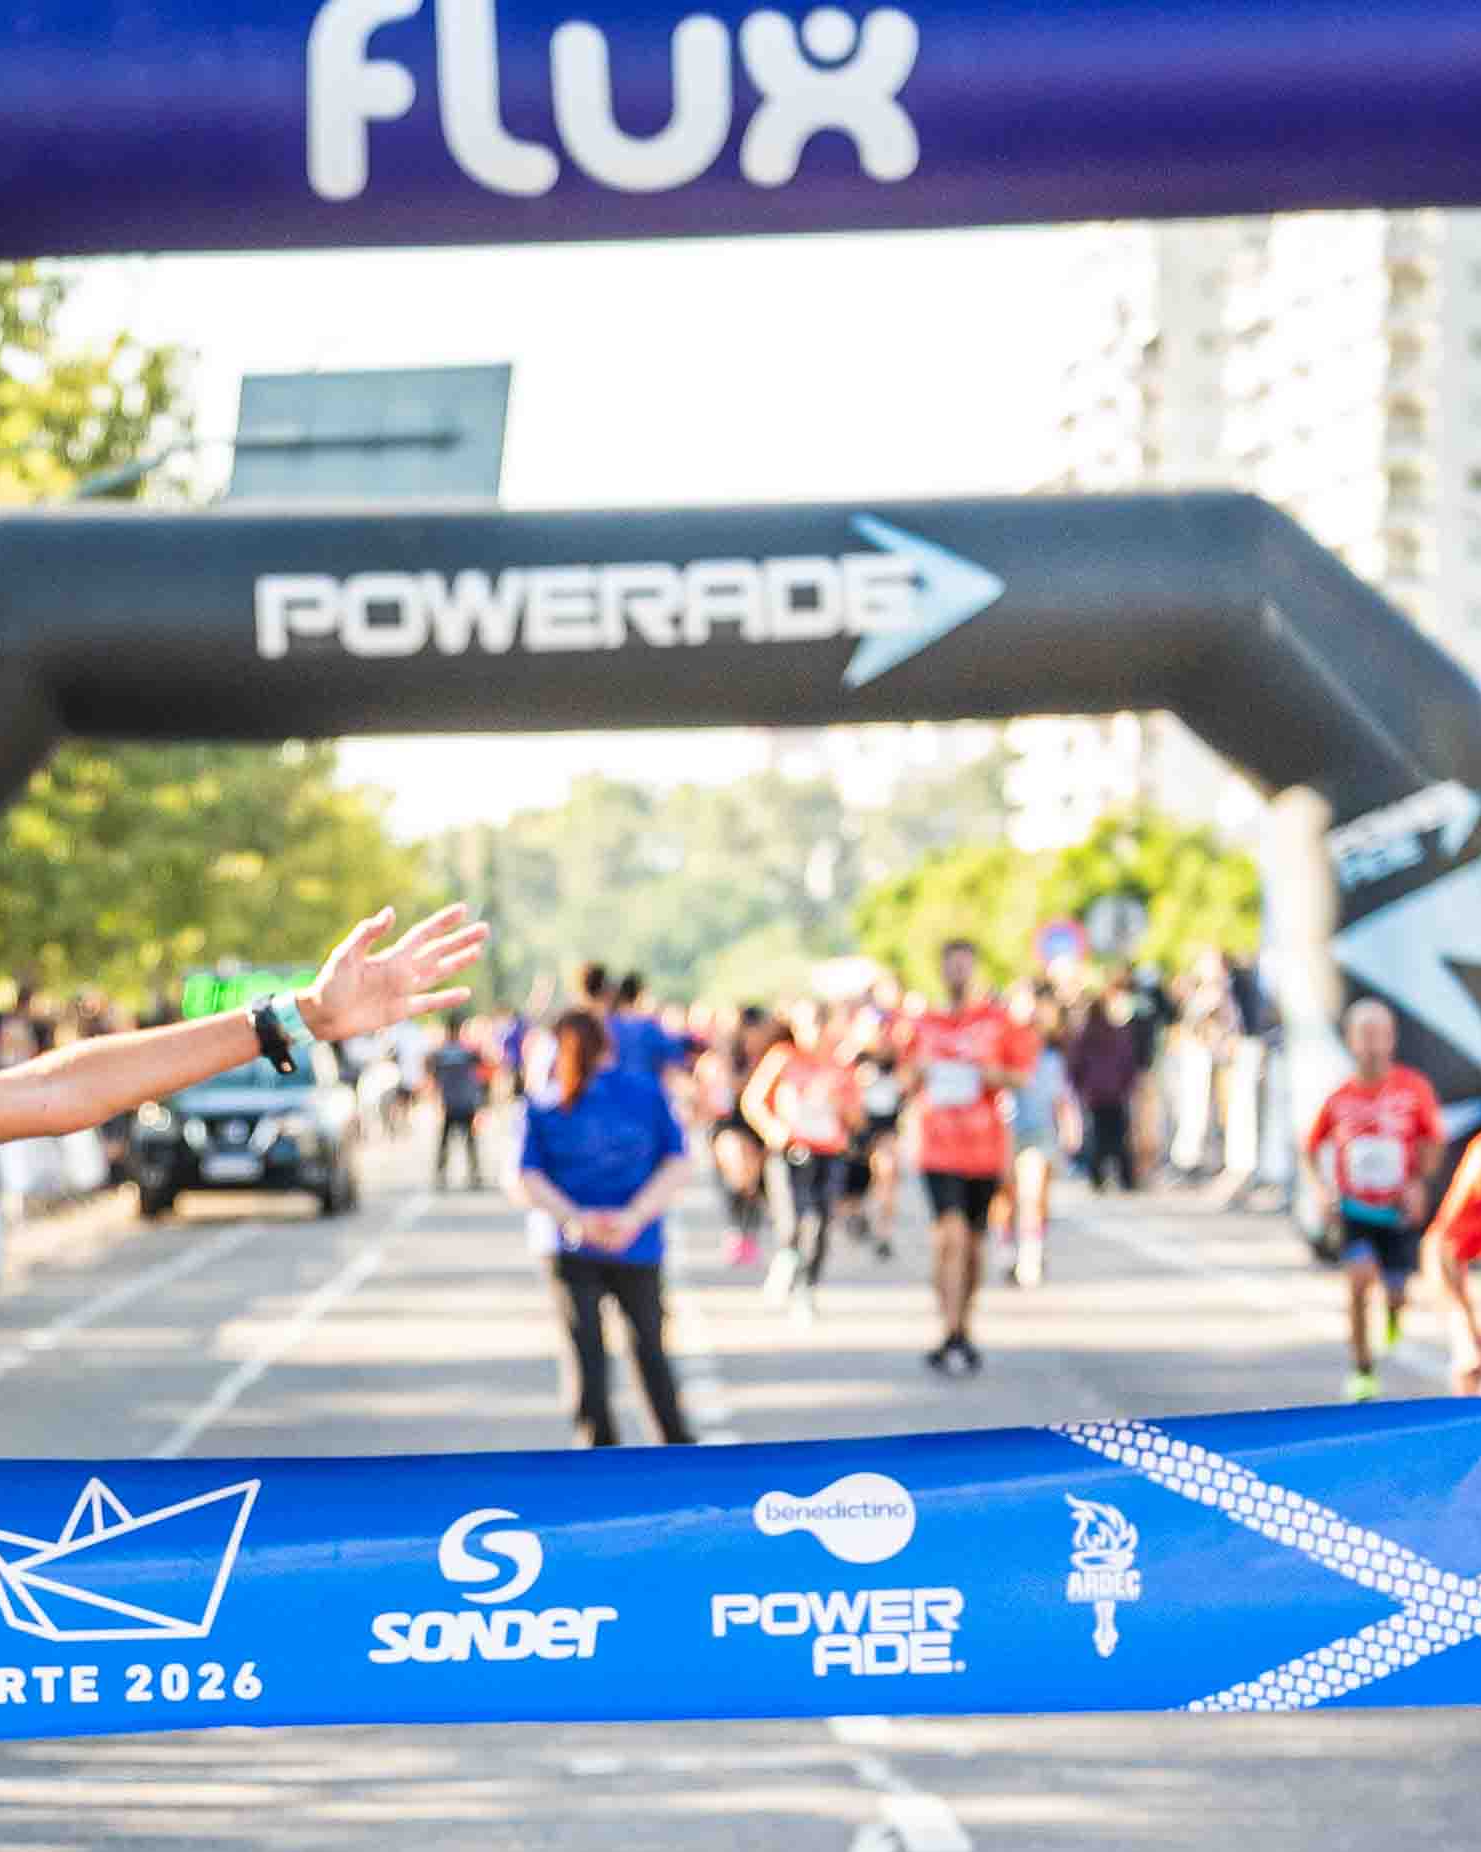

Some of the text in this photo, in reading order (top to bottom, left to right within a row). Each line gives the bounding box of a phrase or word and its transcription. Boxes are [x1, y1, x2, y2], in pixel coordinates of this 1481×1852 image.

[254, 553, 926, 661] POWERADE
[765, 1499, 908, 1521] benedictino
[711, 1587, 965, 1638] POWER
[125, 1661, 263, 1701] 2026
